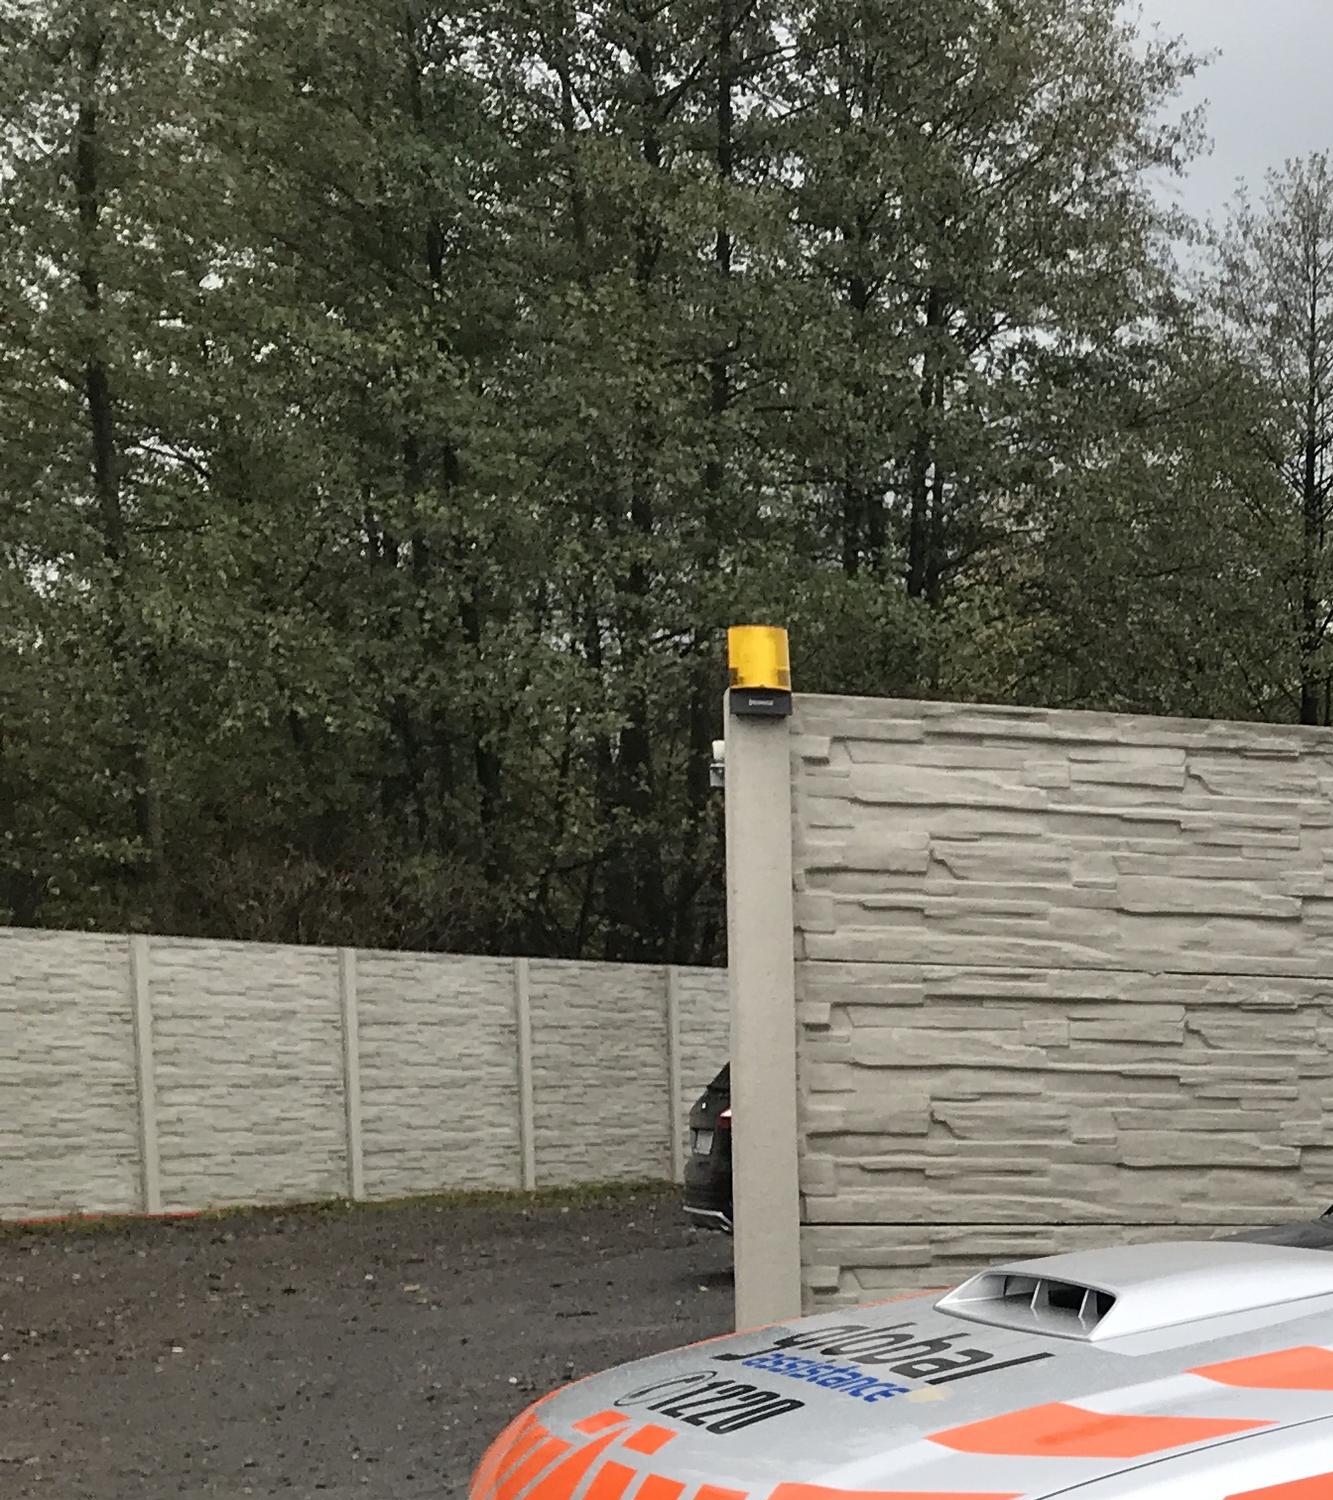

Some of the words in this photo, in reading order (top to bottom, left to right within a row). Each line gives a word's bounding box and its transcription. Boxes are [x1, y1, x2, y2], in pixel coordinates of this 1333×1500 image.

[713, 1322, 1056, 1386] global
[741, 1353, 912, 1403] assistance
[647, 1380, 804, 1434] 1220
